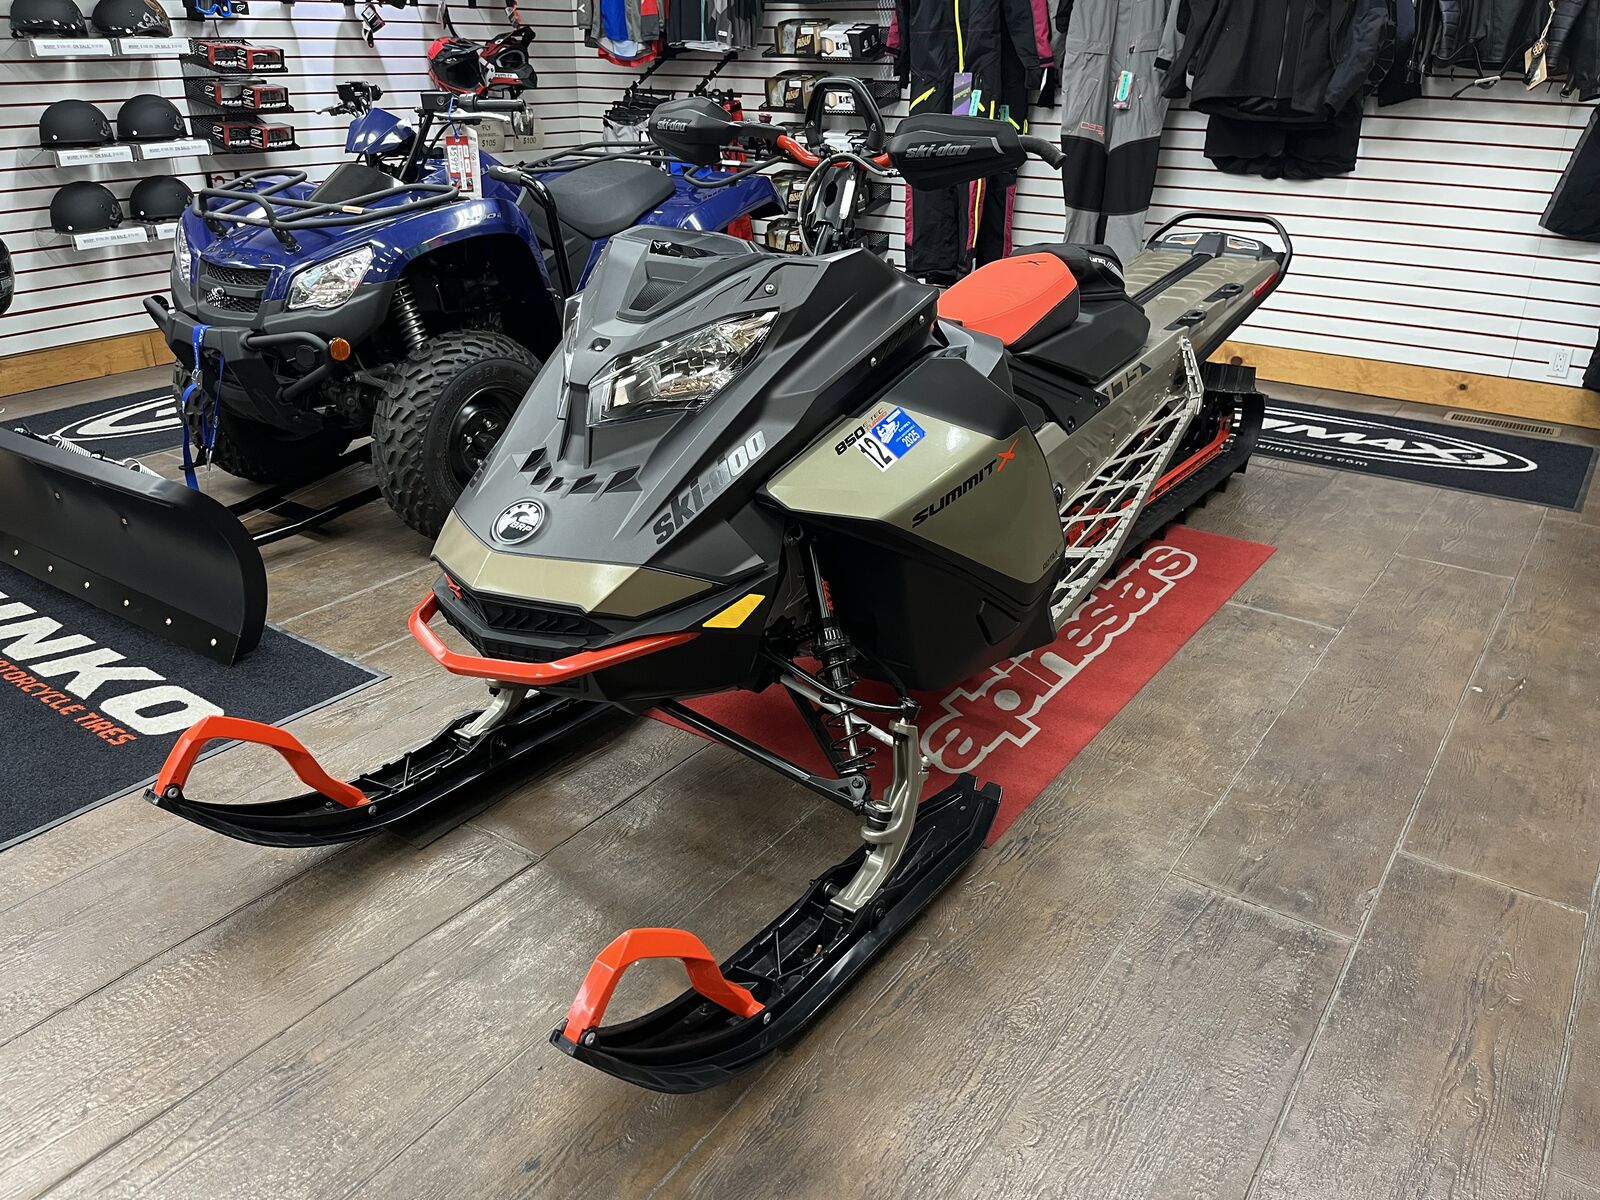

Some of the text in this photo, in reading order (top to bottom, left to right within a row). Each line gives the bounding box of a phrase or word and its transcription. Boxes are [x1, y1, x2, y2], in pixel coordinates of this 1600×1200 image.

[481, 138, 497, 148] $105
[523, 136, 537, 145] $100
[905, 143, 971, 158] ski-doo
[834, 425, 866, 456] 850
[901, 430, 920, 448] 2025
[858, 437, 893, 469] 12
[911, 437, 1021, 529] SUMMIT X
[509, 521, 533, 532] BRP
[919, 545, 1198, 775] alpinestars
[73, 711, 137, 746] TIRES
